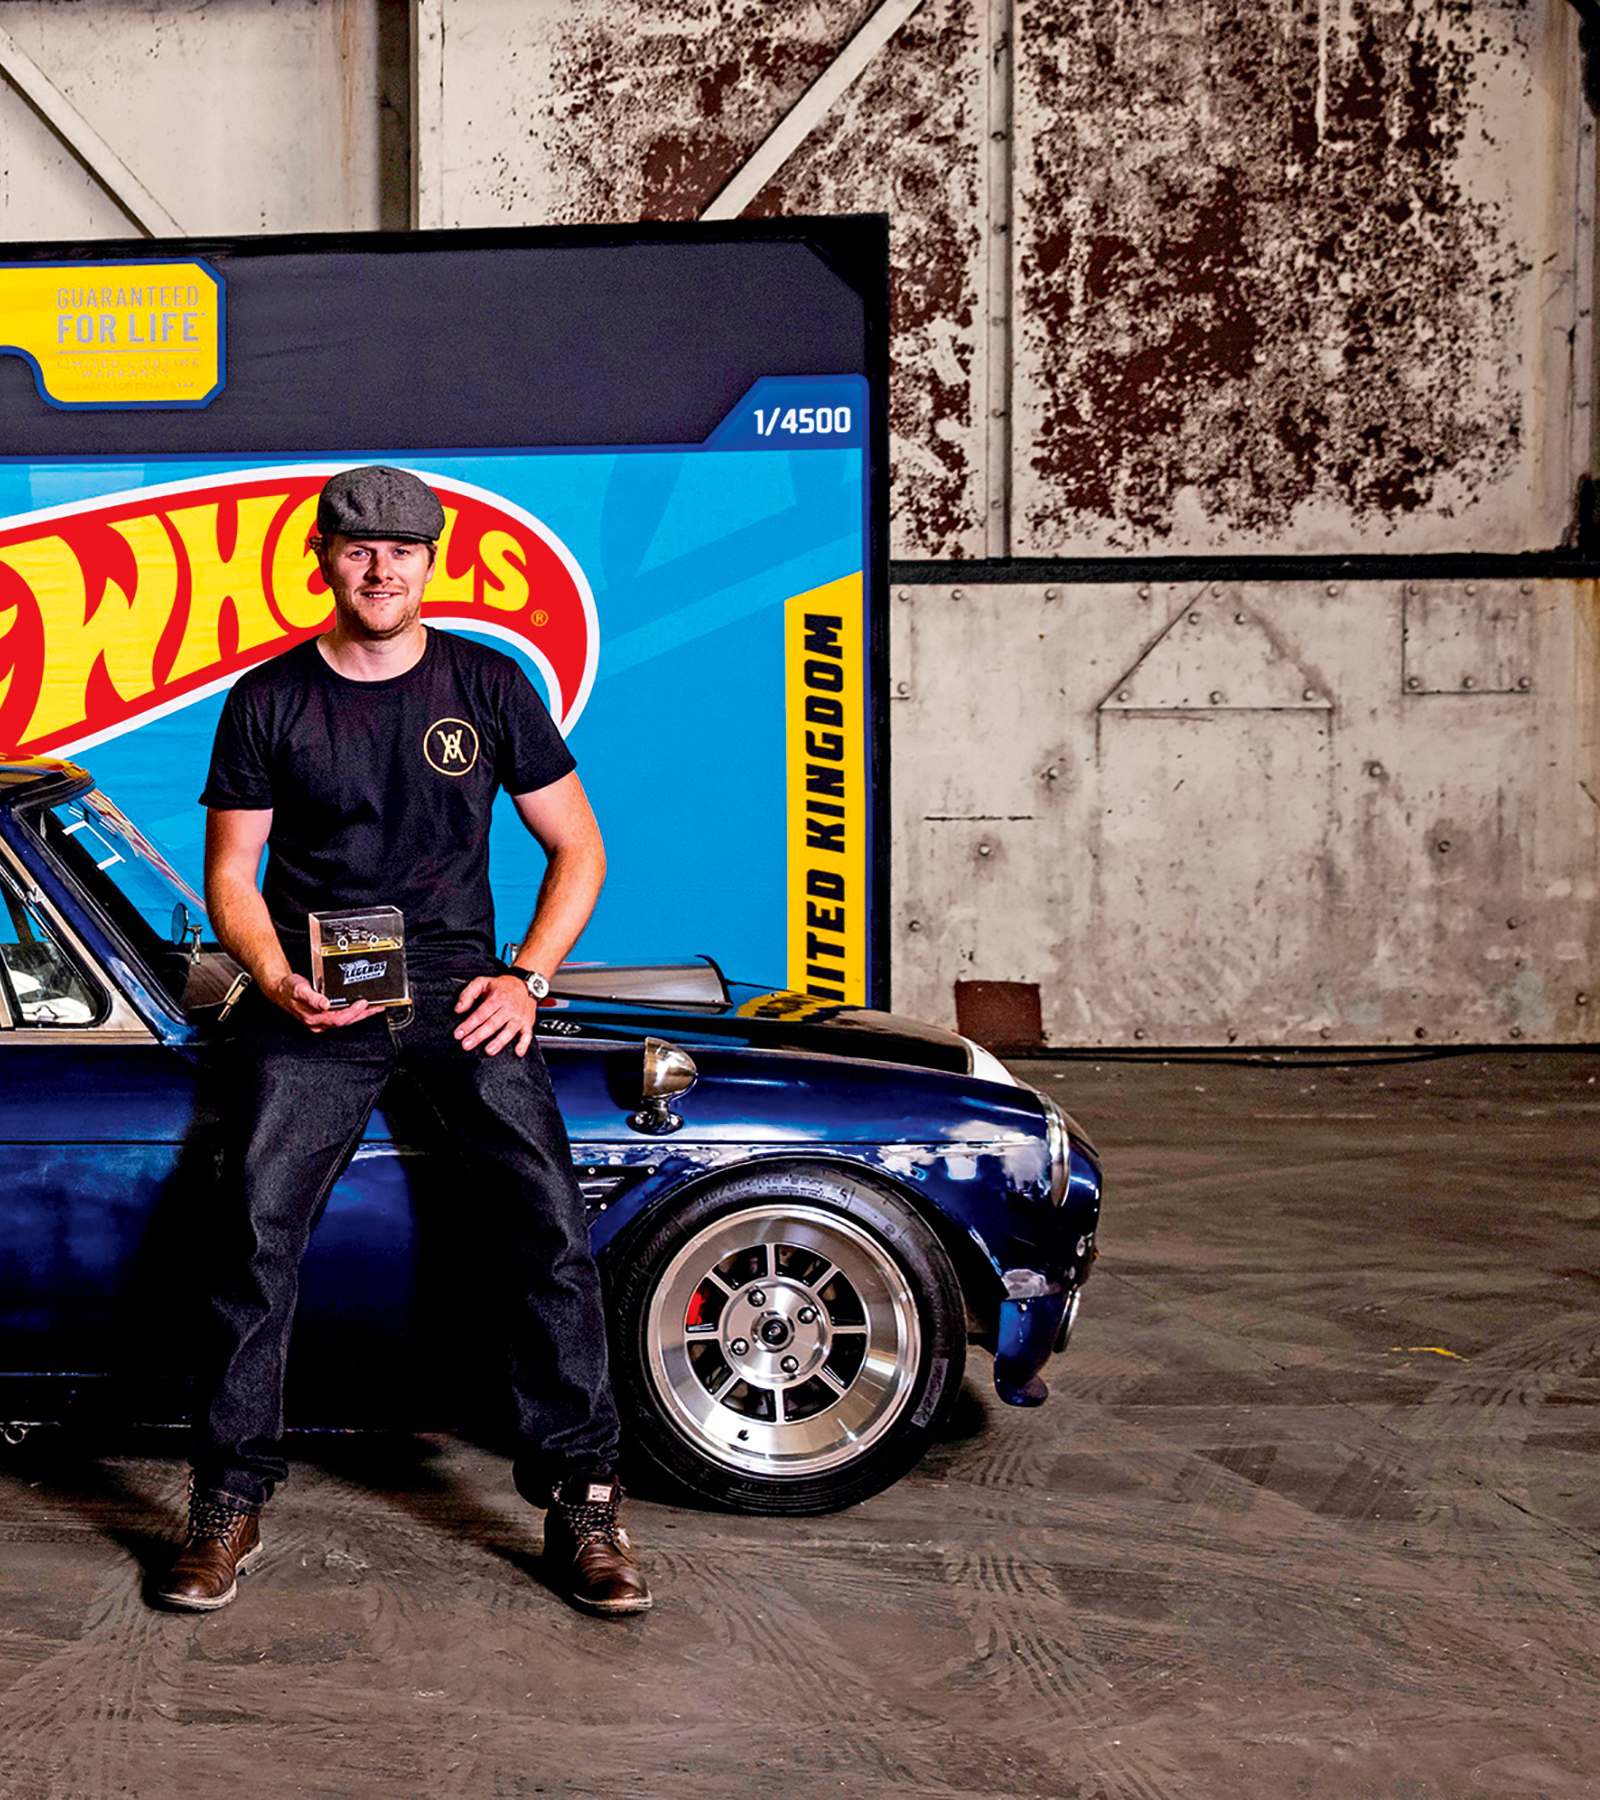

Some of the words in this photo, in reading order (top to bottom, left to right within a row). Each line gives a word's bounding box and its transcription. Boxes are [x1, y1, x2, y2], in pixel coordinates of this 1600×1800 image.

[57, 285, 199, 309] GUARANTEED
[57, 314, 117, 344] FOR
[753, 406, 851, 437] 1/4500
[804, 612, 846, 855] KINGDOM
